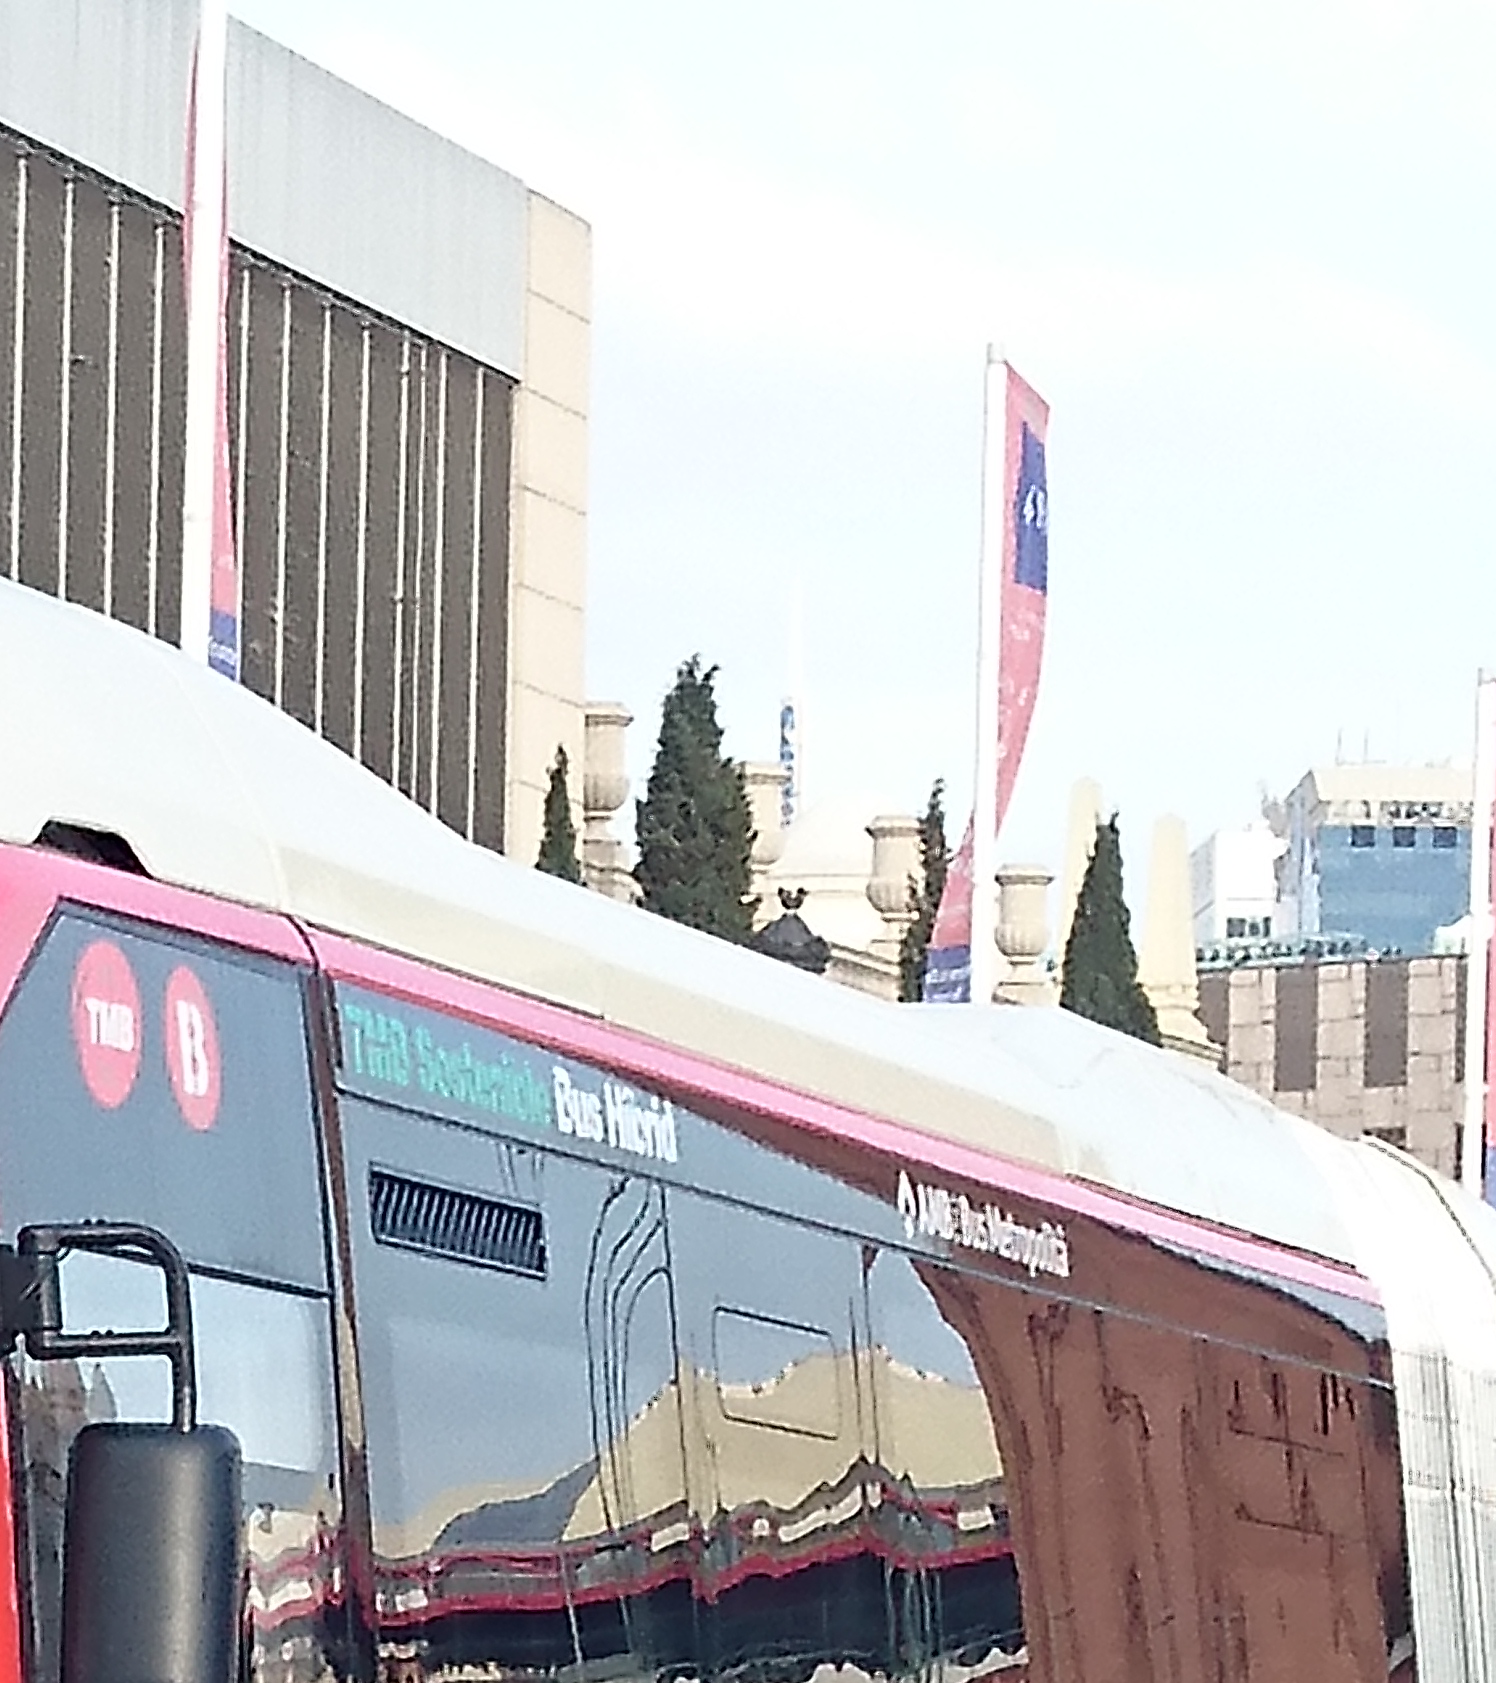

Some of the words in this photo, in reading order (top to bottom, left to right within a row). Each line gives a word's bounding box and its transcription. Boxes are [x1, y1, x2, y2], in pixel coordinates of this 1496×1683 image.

[84, 997, 135, 1052] TMB
[176, 999, 209, 1097] B
[343, 1003, 409, 1087] TMB
[553, 1065, 605, 1143] Bus
